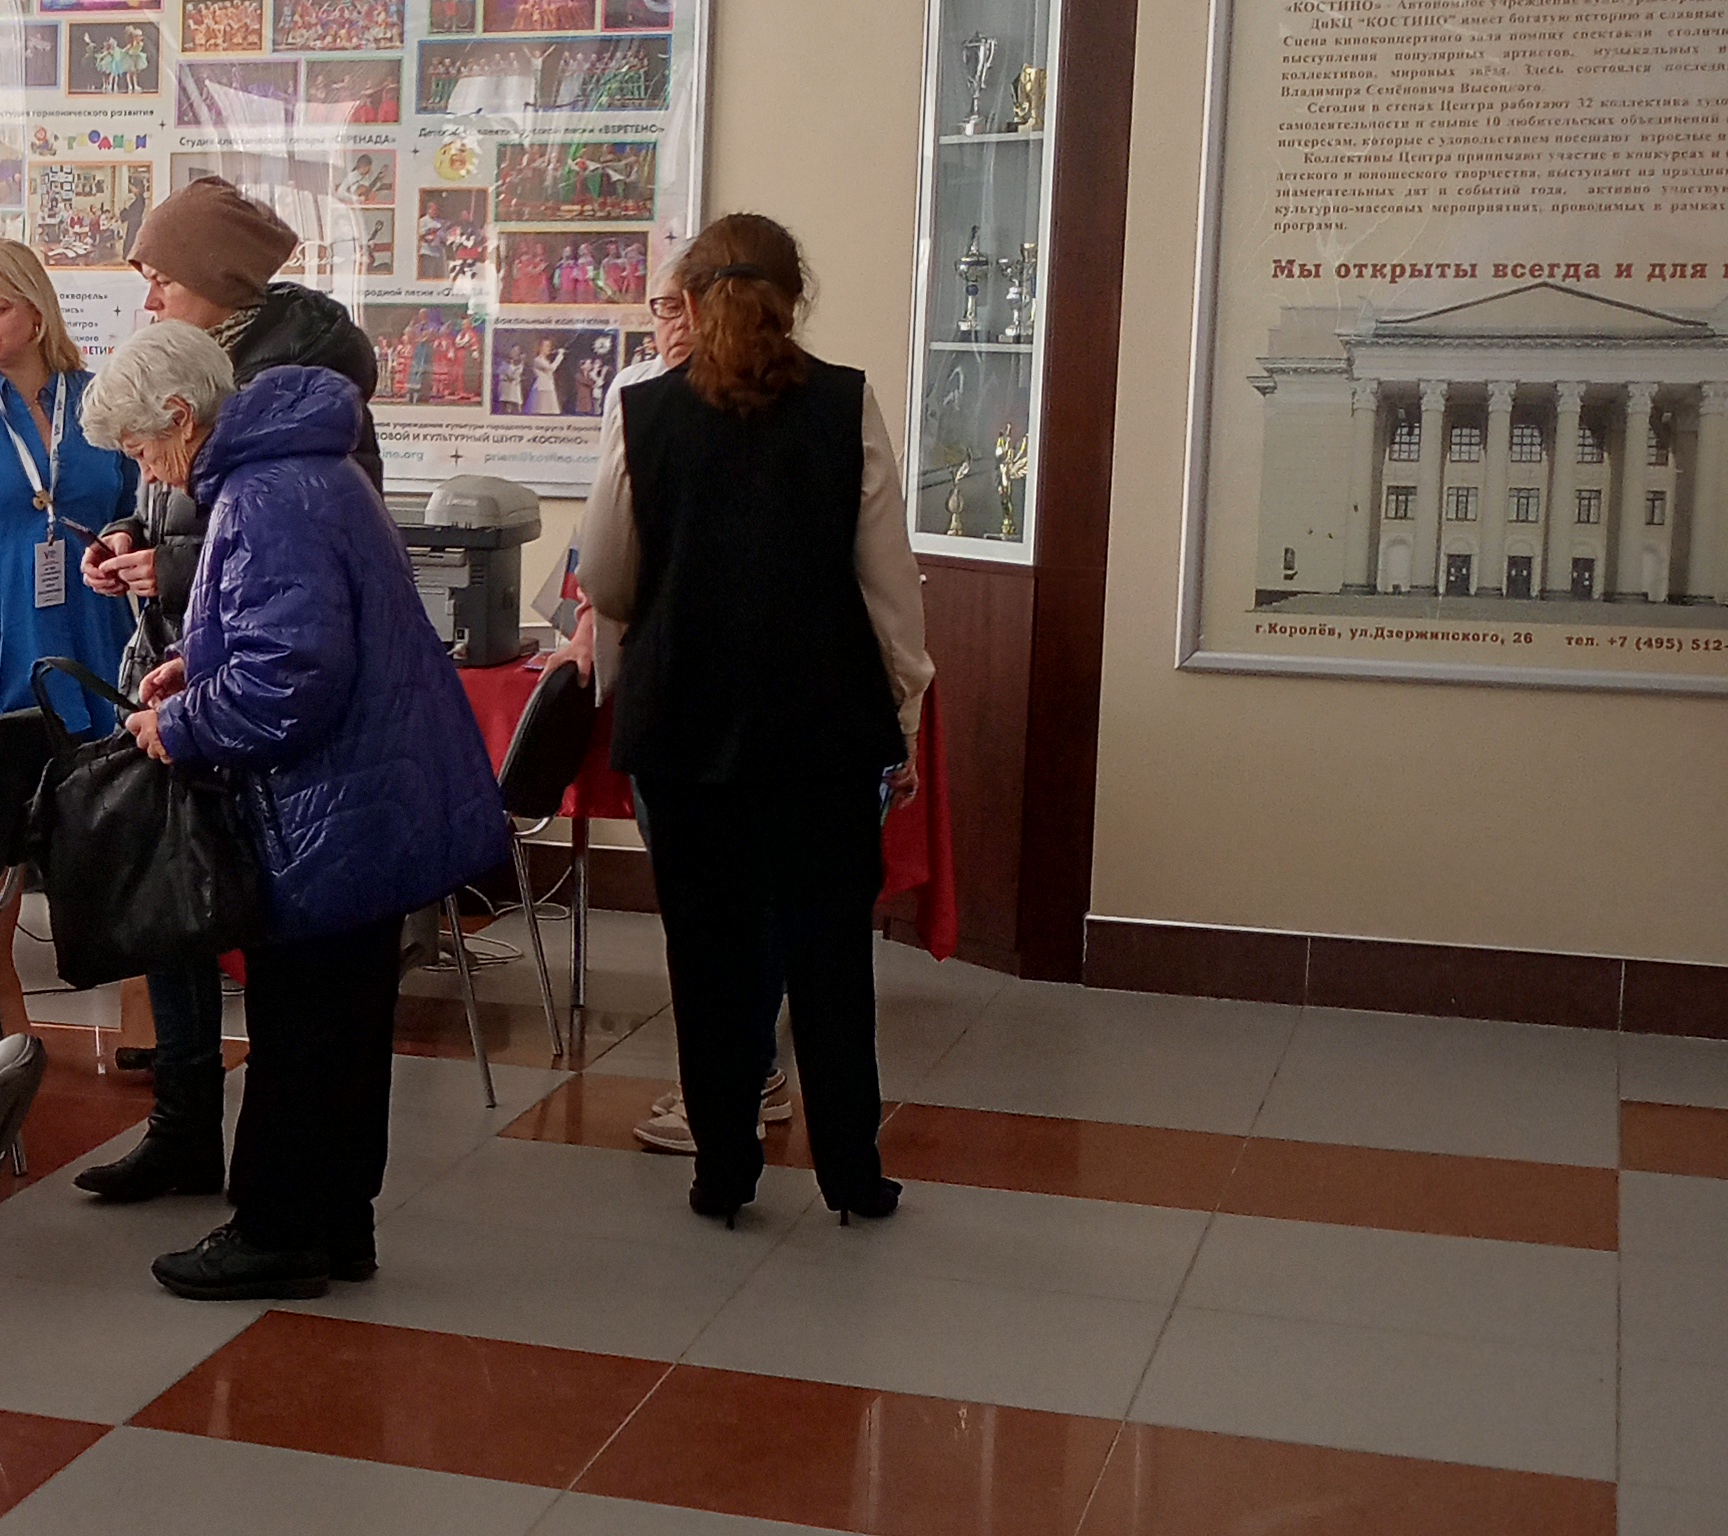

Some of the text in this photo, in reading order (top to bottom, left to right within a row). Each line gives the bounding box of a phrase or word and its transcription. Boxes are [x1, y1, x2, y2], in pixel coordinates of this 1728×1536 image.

[1271, 258, 1322, 280] Мы
[1334, 262, 1478, 284] открыты
[1492, 262, 1601, 283] всегда
[1614, 262, 1634, 279] и
[1646, 262, 1708, 283] для
[412, 432, 421, 442] И
[1512, 631, 1534, 645] 26
[1565, 635, 1599, 647] тел.
[1608, 635, 1628, 648] +7
[1635, 637, 1683, 652] (495)
